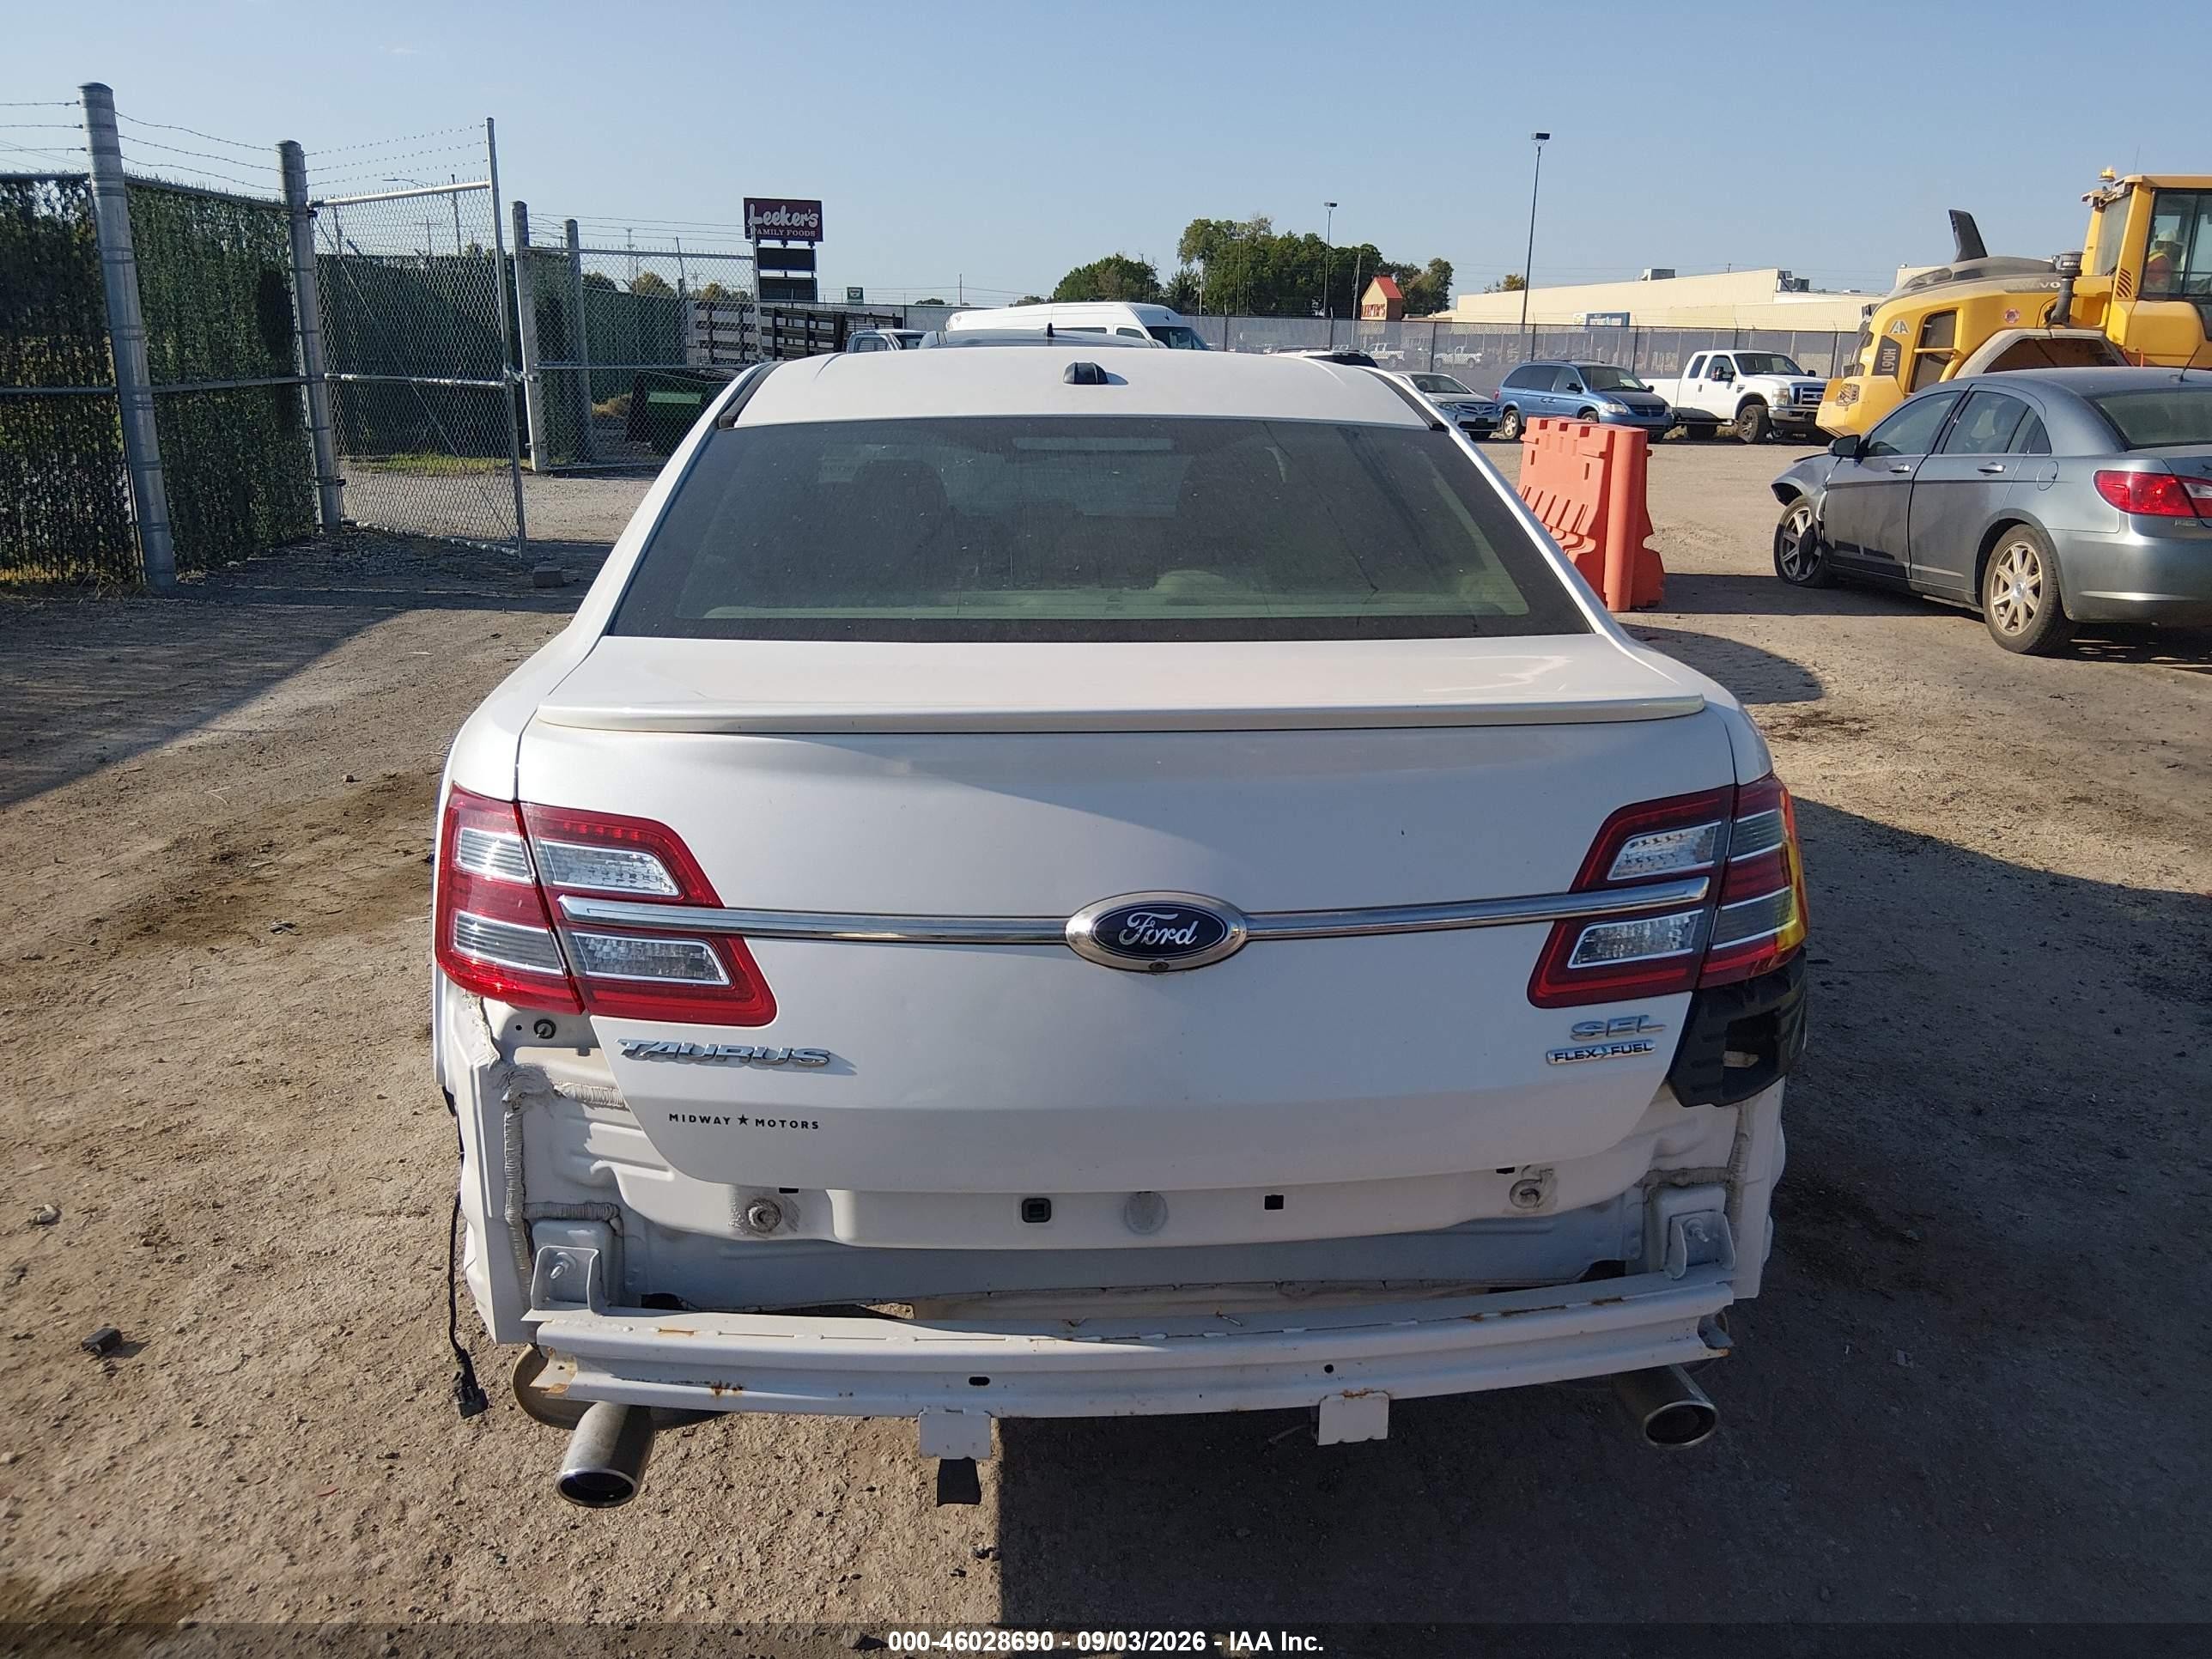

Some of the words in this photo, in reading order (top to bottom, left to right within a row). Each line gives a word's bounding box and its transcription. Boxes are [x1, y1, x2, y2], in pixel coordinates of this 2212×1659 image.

[748, 204, 819, 228] Leeker's
[1881, 348, 1896, 372] L90H
[1118, 911, 1200, 945] Ford
[1570, 1015, 1667, 1041] SEL
[614, 1038, 832, 1067] TAURUS
[1553, 1048, 1598, 1062] FLEX
[1610, 1042, 1656, 1056] FUEL
[668, 1113, 731, 1126] MIDWAY
[755, 1118, 820, 1130] MOTORS
